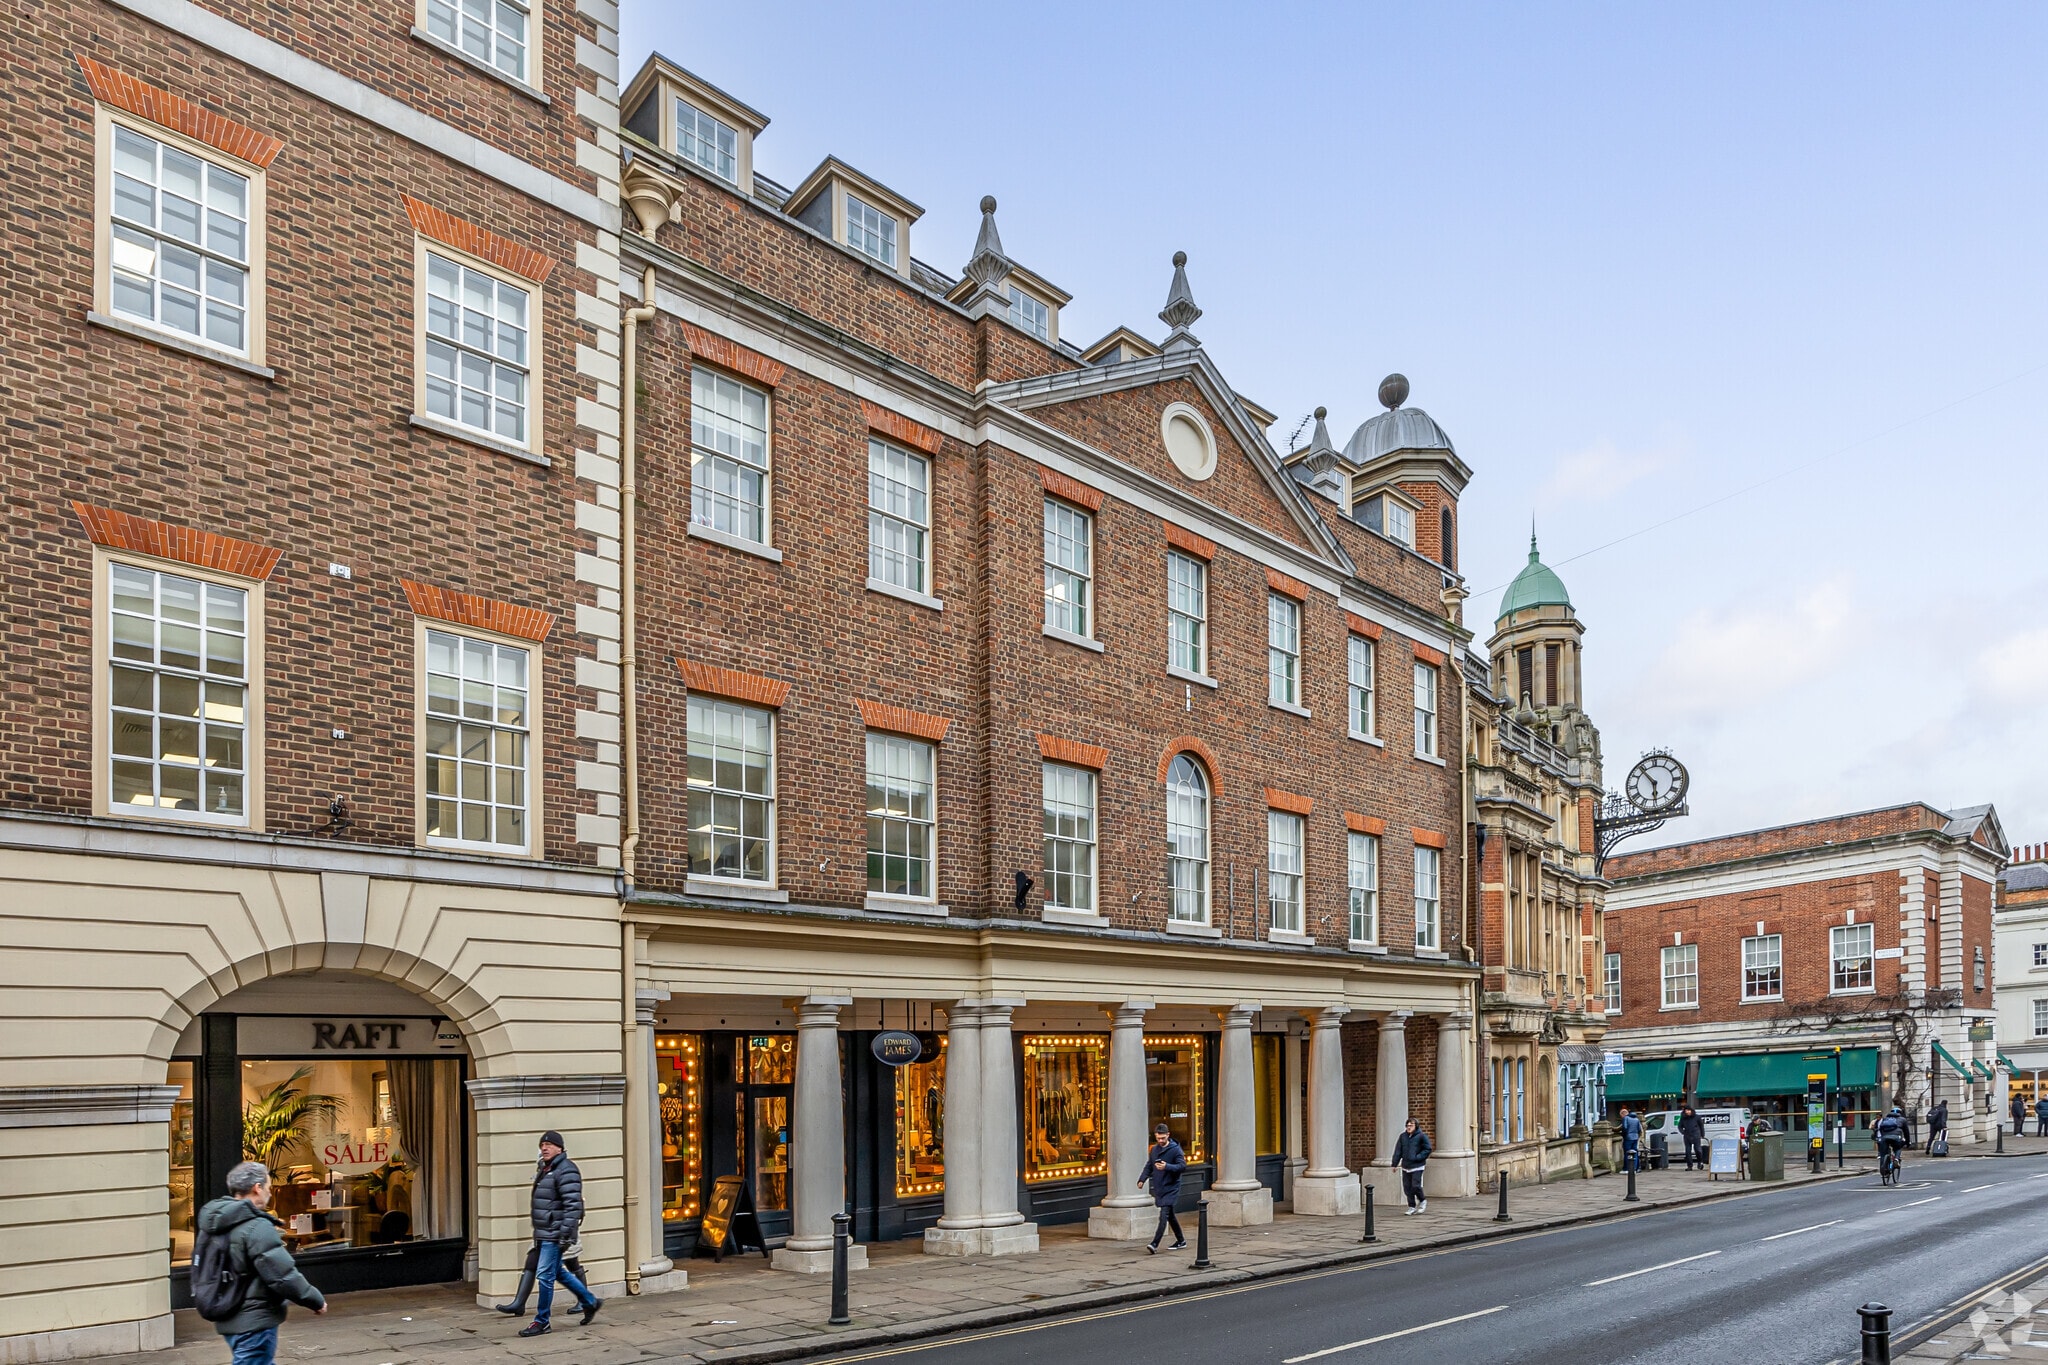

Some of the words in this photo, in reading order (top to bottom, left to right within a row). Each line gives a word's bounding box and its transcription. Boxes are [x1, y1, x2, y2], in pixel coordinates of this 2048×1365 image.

[312, 1022, 406, 1050] RAFT
[883, 1038, 912, 1046] EDWARD
[885, 1045, 912, 1056] JAMES
[324, 1142, 389, 1166] SALE
